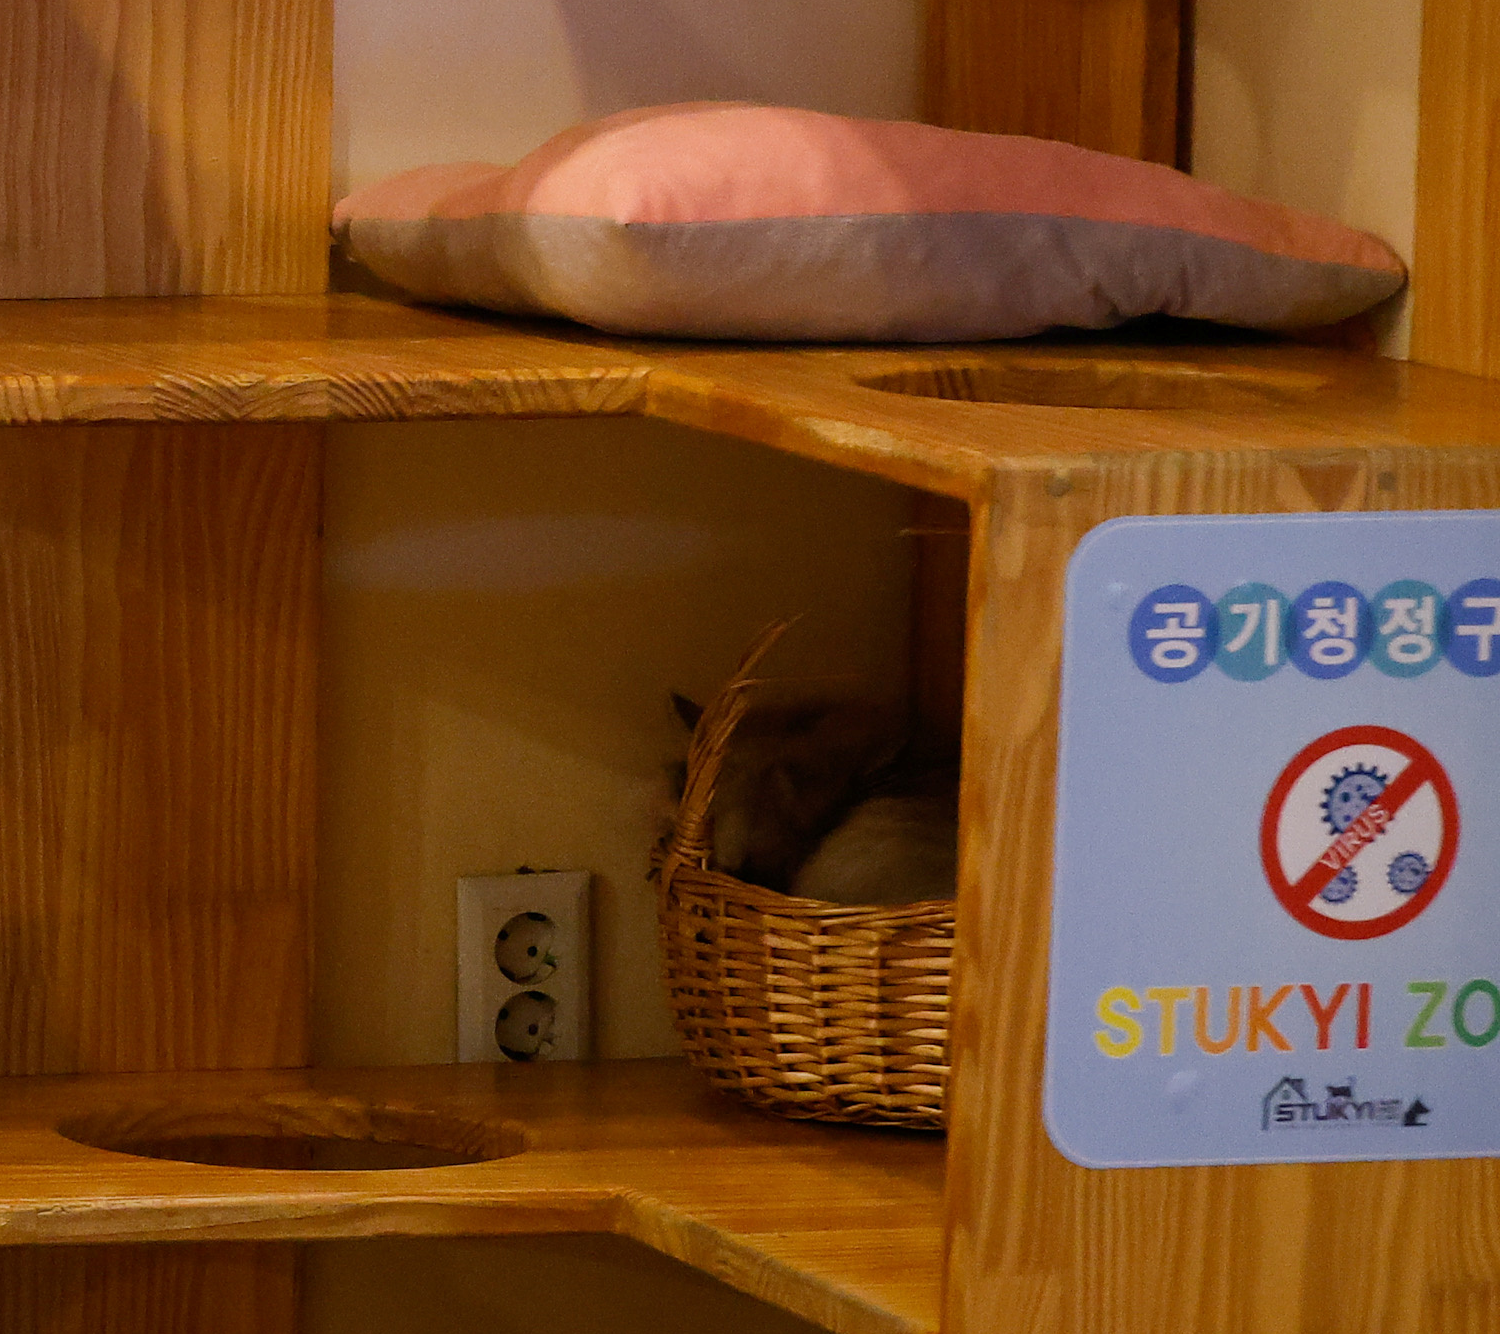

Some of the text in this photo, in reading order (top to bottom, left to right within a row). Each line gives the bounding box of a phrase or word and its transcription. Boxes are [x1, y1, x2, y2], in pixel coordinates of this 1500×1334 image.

[1319, 802, 1392, 870] VIRUS
[1093, 979, 1500, 1059] STUKYI ZO
